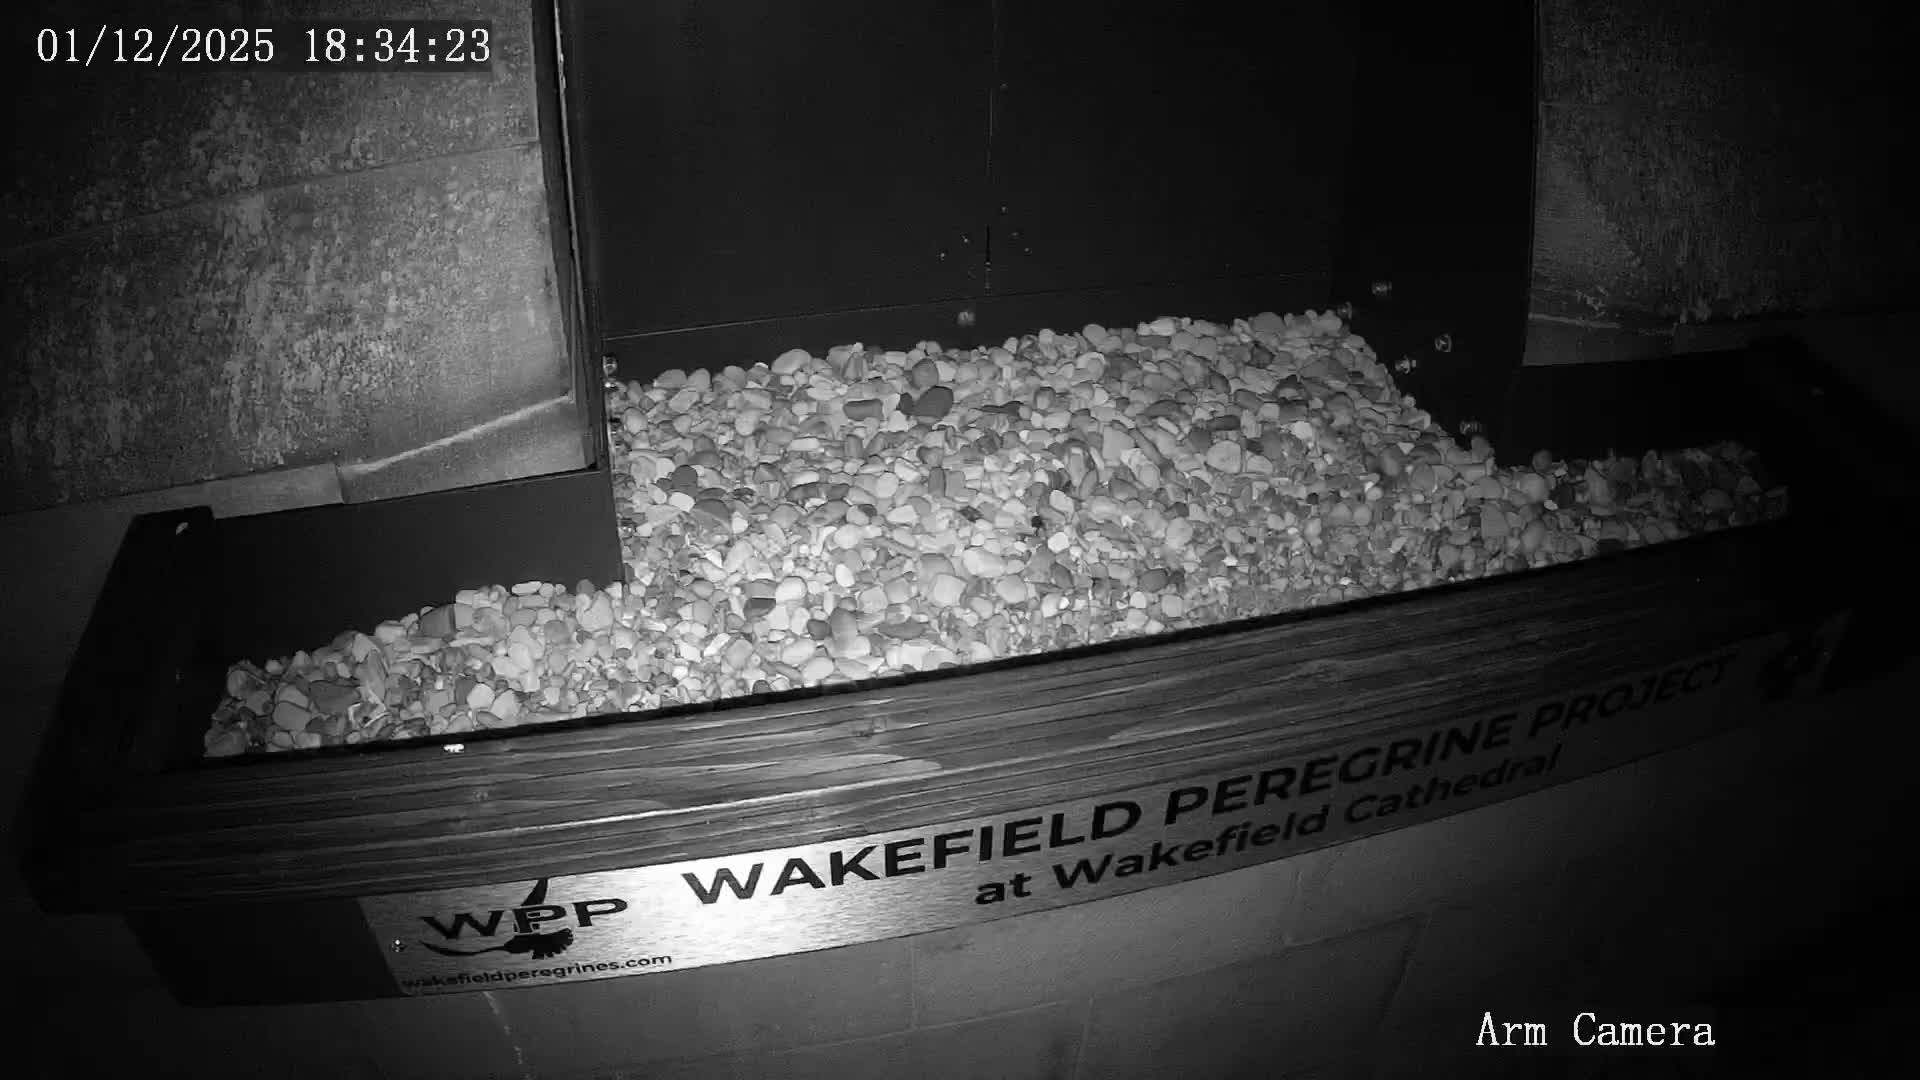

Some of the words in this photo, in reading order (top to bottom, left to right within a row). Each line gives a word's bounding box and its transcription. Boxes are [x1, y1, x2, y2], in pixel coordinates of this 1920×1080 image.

[682, 801, 1142, 904] WAKEFIELD
[1165, 714, 1518, 825] PEREGRINE
[1529, 653, 1740, 737] PROJECT
[976, 873, 1031, 905] at
[1053, 805, 1330, 889] Wakefield
[1344, 743, 1562, 854] Cathedral
[401, 953, 672, 987] wakefieldperegrines.com
[419, 898, 628, 940] WPP
